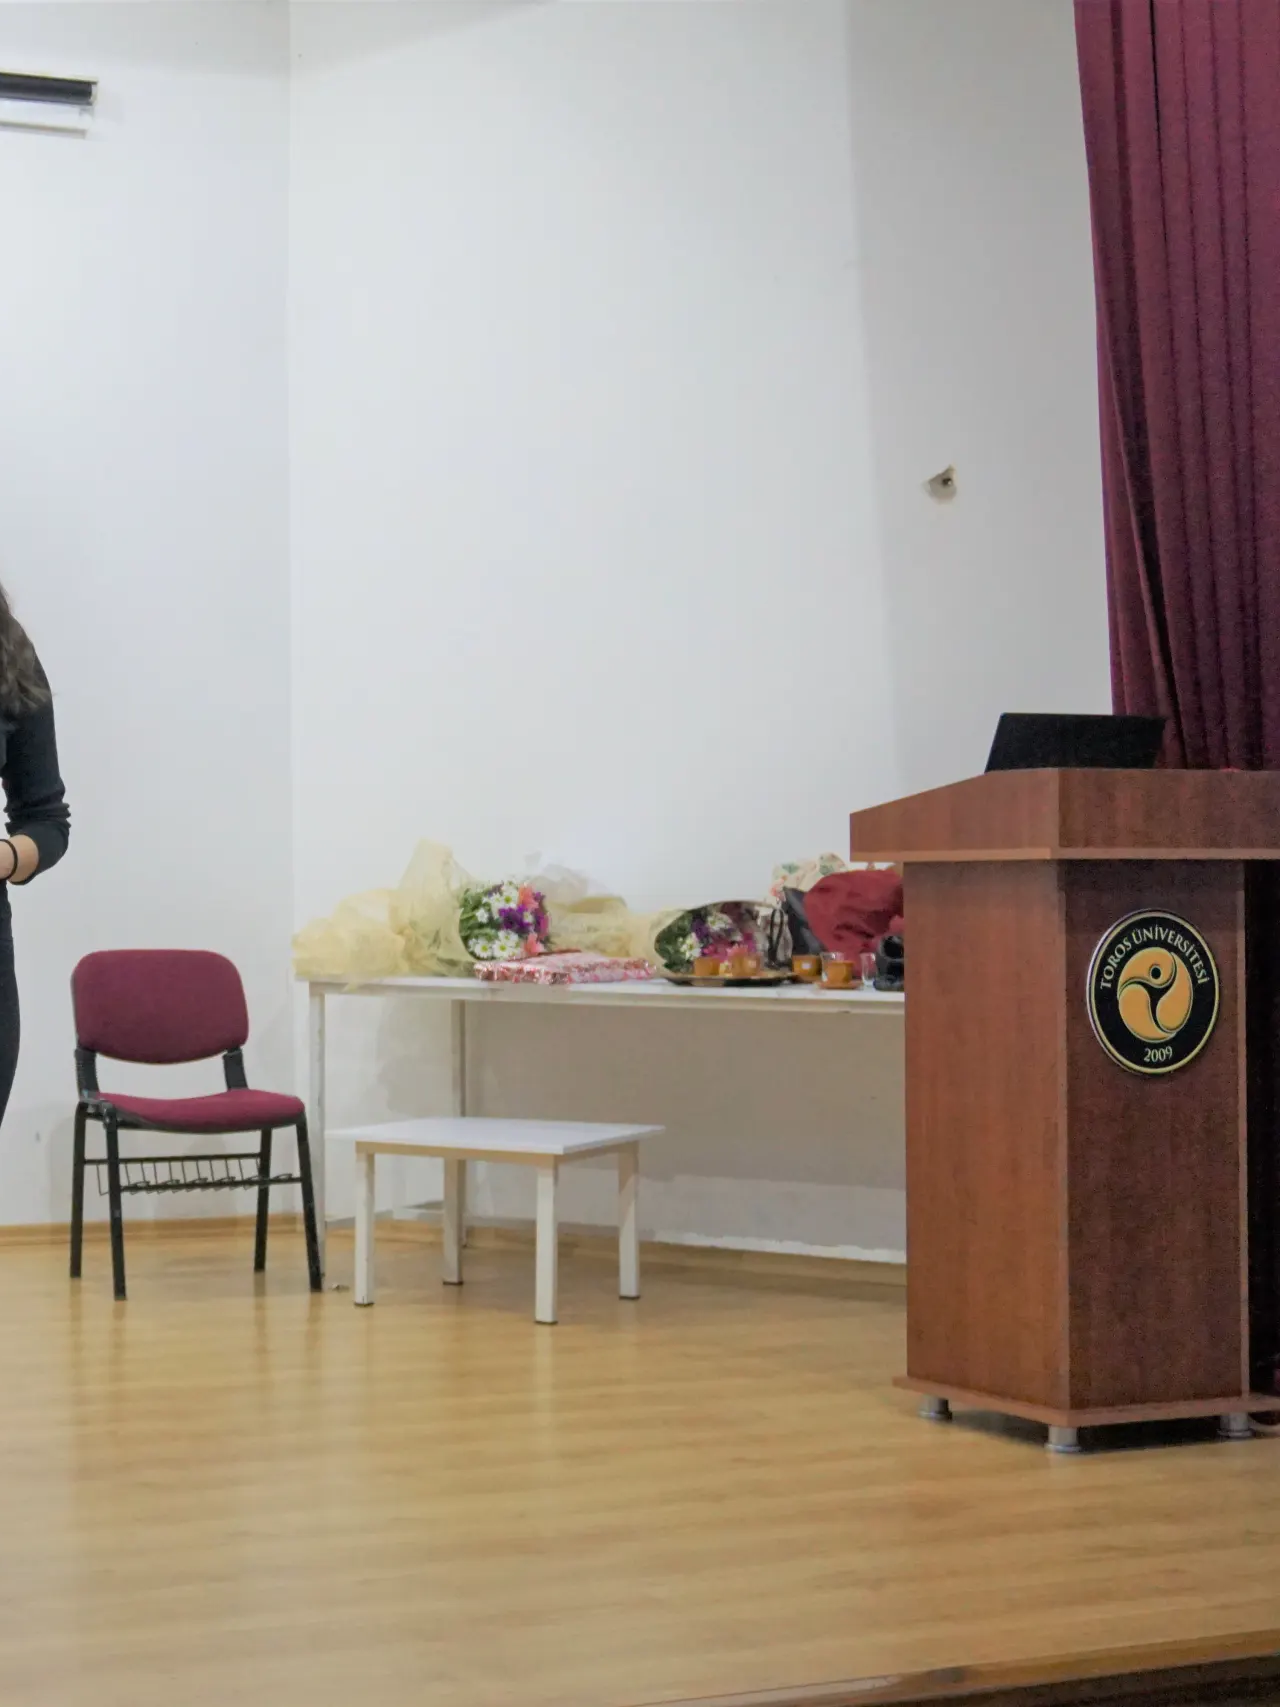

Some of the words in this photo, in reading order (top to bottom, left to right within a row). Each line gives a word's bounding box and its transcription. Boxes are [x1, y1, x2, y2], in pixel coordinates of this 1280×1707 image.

[1100, 937, 1132, 990] TOROS
[1132, 924, 1210, 984] ÜNİVERSİTESİ
[1143, 1046, 1173, 1063] 2009
